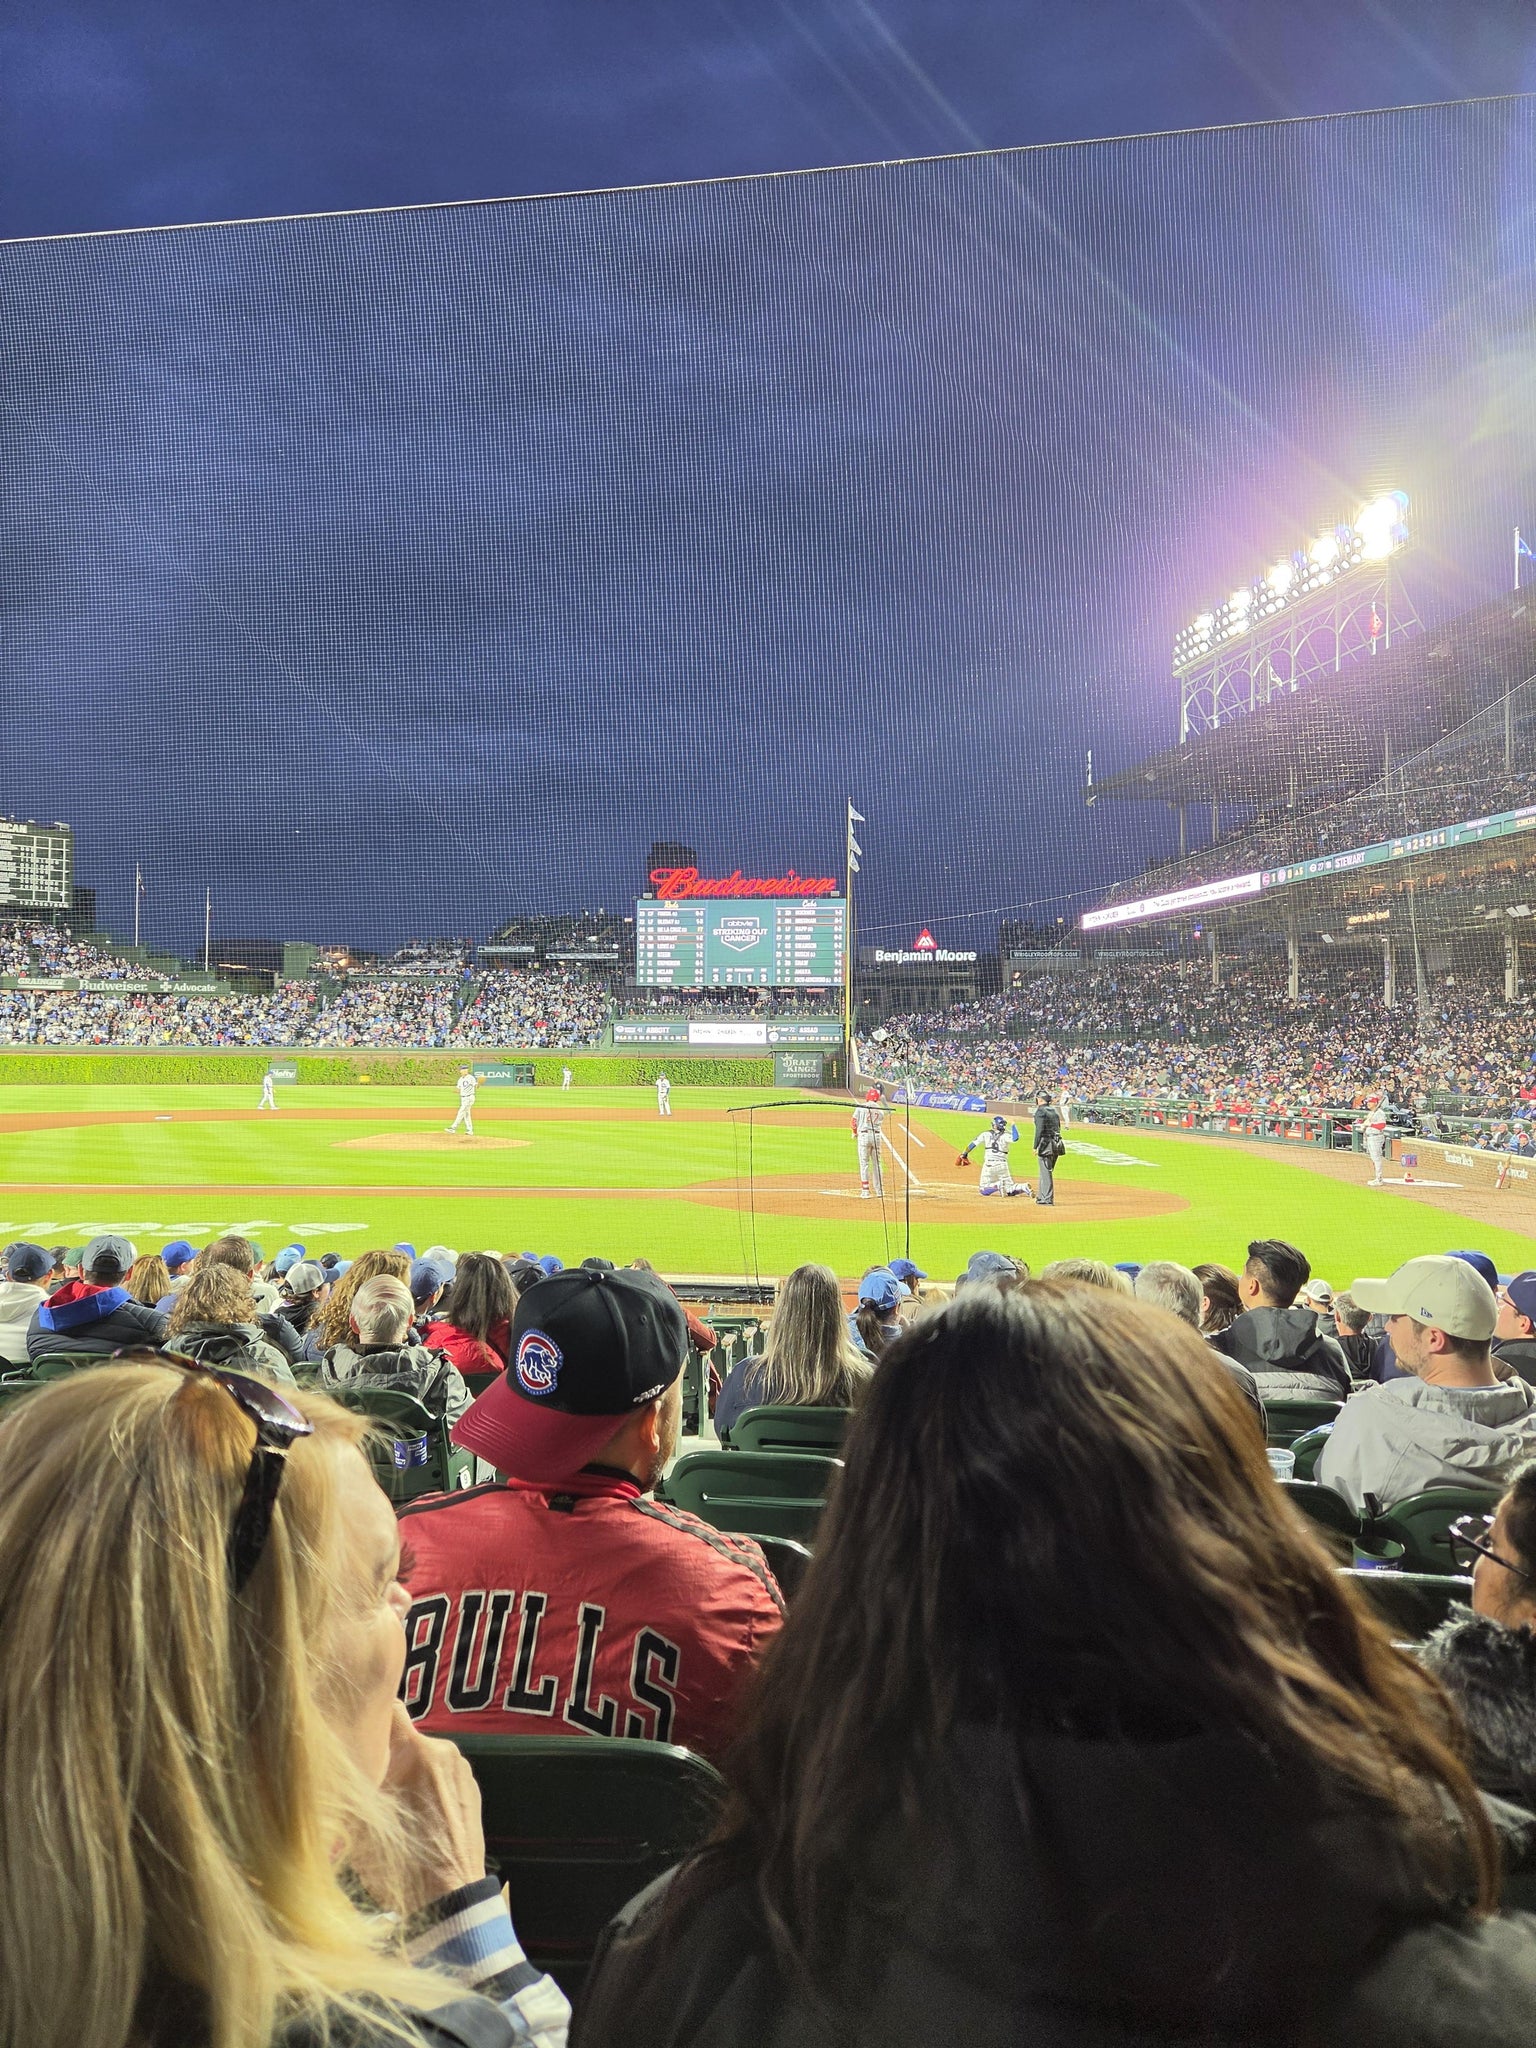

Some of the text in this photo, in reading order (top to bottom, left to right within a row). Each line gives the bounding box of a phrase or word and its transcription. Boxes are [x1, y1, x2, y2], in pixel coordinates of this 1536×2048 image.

[1334, 853, 1365, 868] STEWART
[650, 866, 836, 899] Budweiser
[875, 949, 977, 964] Benjamin Moore
[18, 978, 64, 986] GRAINGER
[712, 974, 719, 982] 3
[726, 974, 733, 982] 2
[747, 974, 752, 982] 1
[173, 983, 216, 992] Advocate
[783, 1059, 817, 1067] DRAFT
[397, 1589, 681, 1743] BULLS
